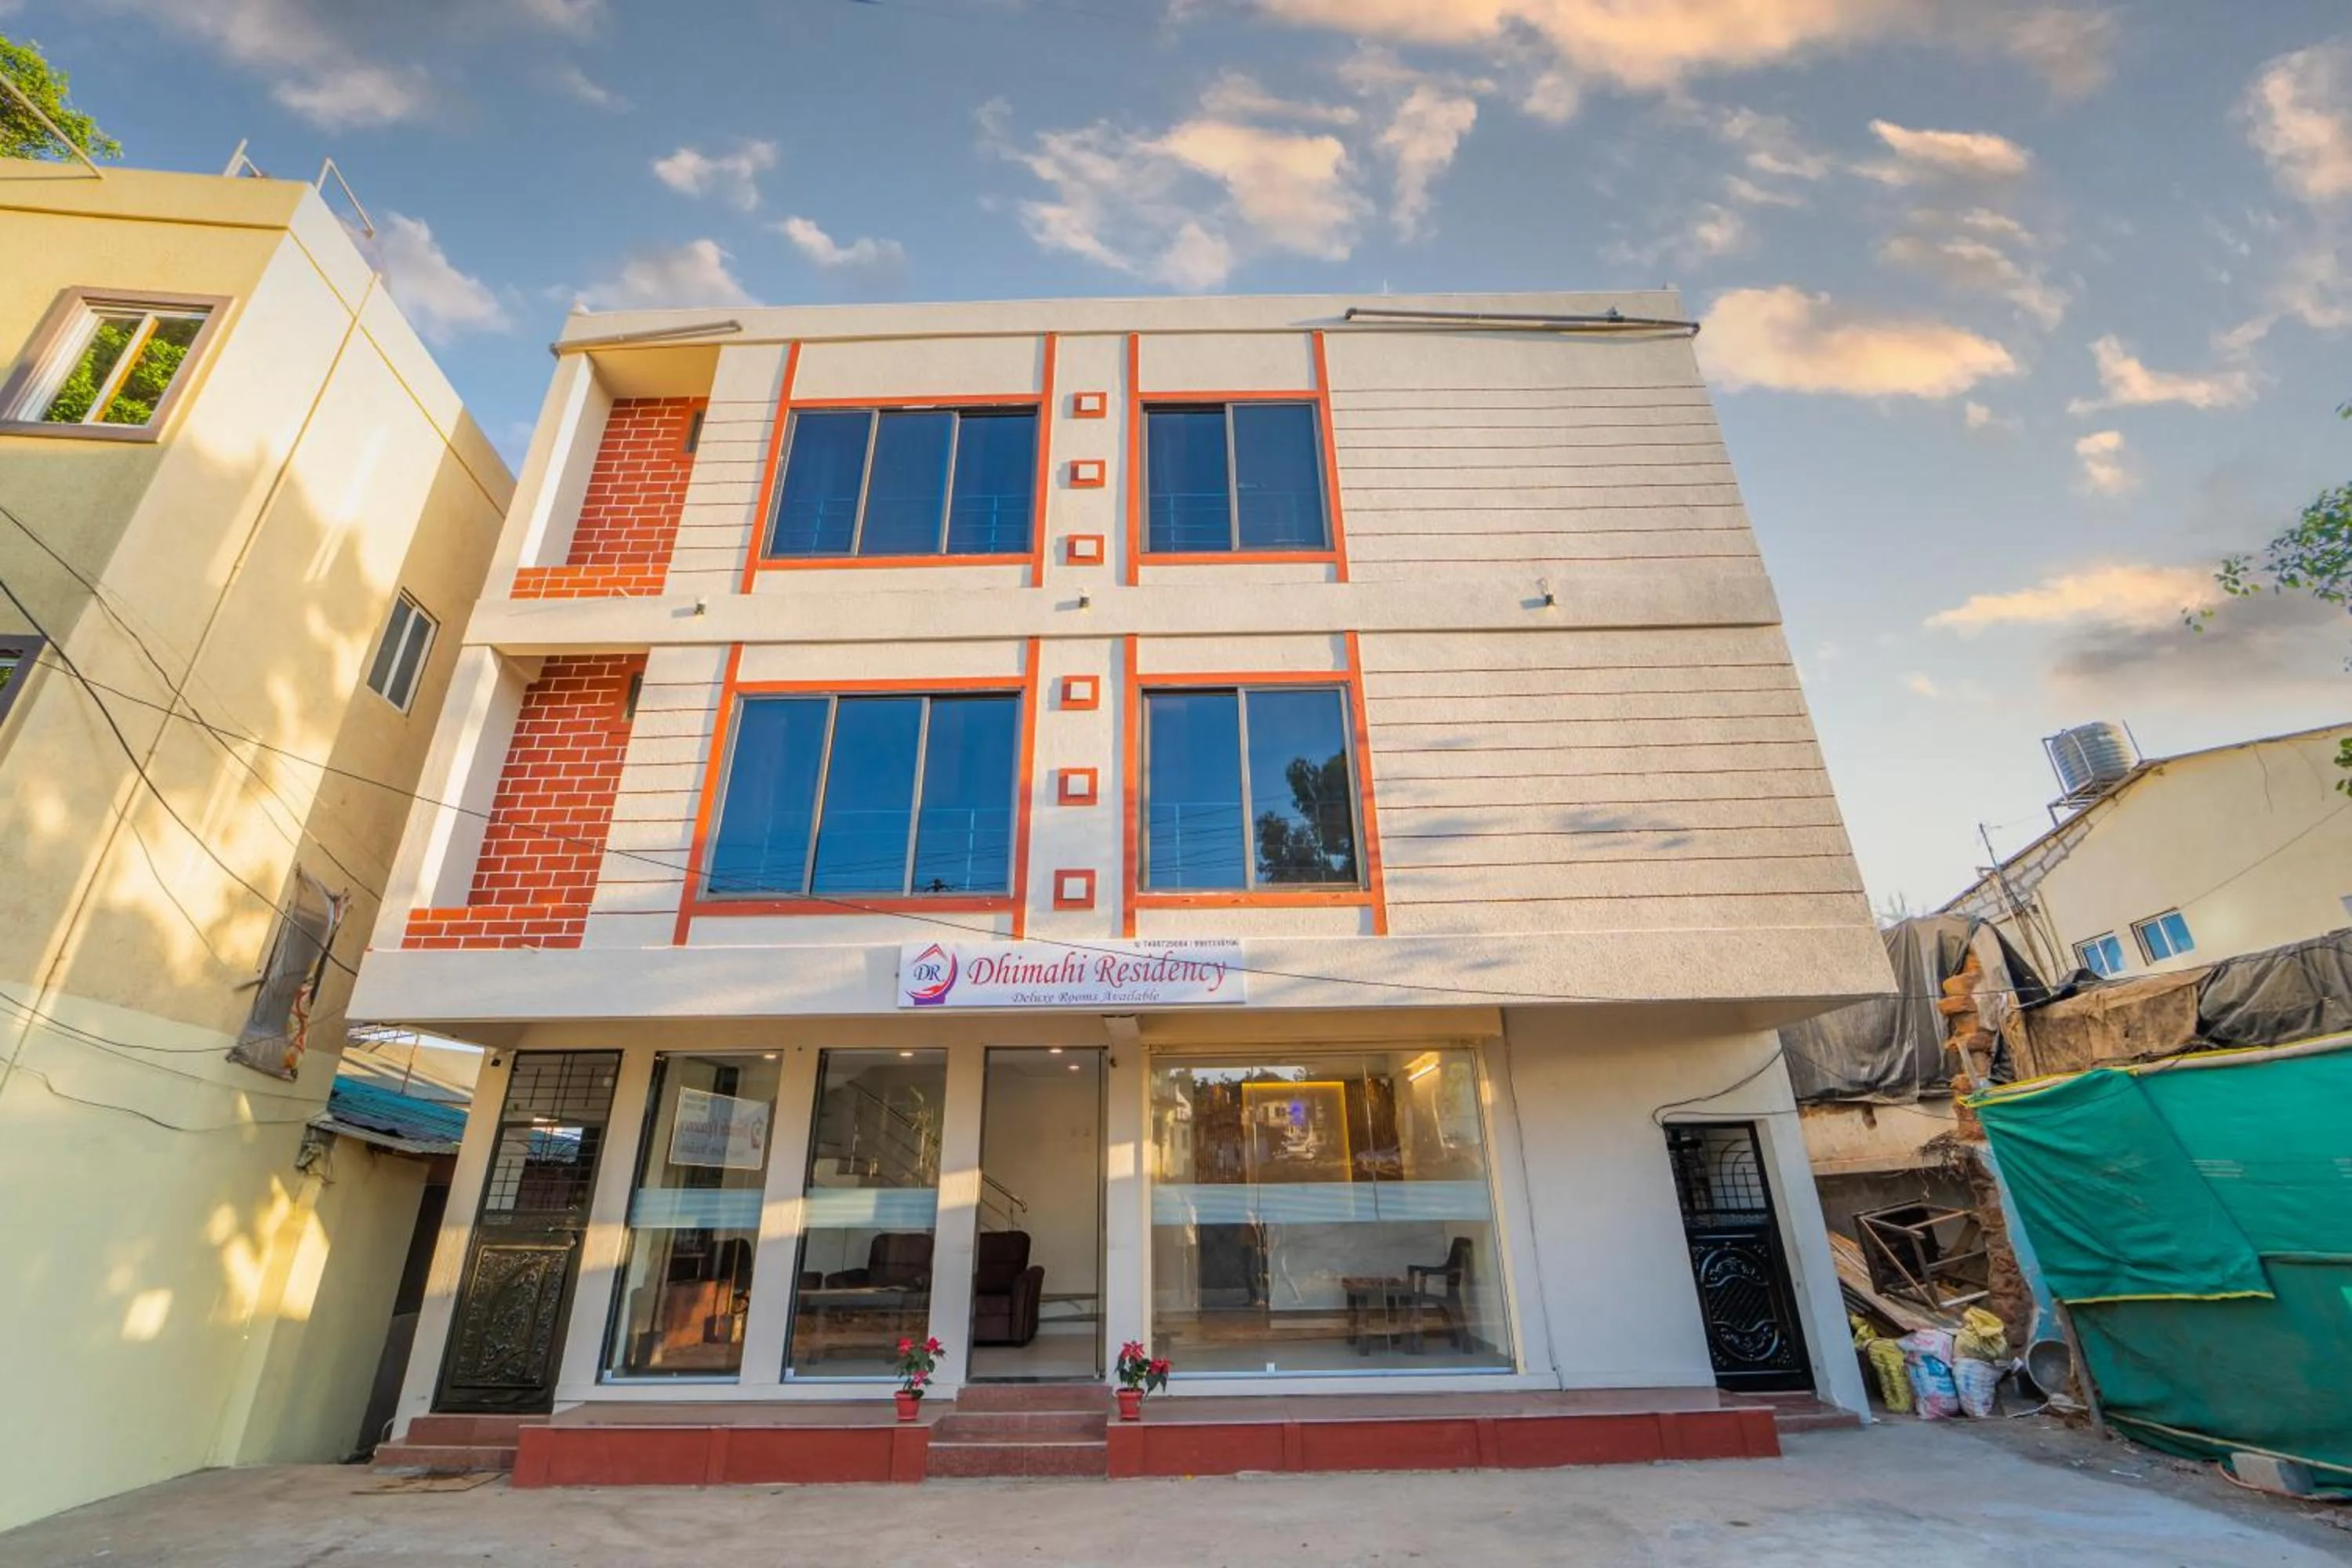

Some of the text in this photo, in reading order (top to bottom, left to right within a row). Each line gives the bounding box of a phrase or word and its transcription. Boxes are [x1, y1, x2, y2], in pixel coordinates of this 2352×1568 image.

[913, 964, 942, 982] DR
[967, 950, 1226, 992] Dhimahi Residency
[1011, 988, 1160, 1004] Deluxe Rooms Available
